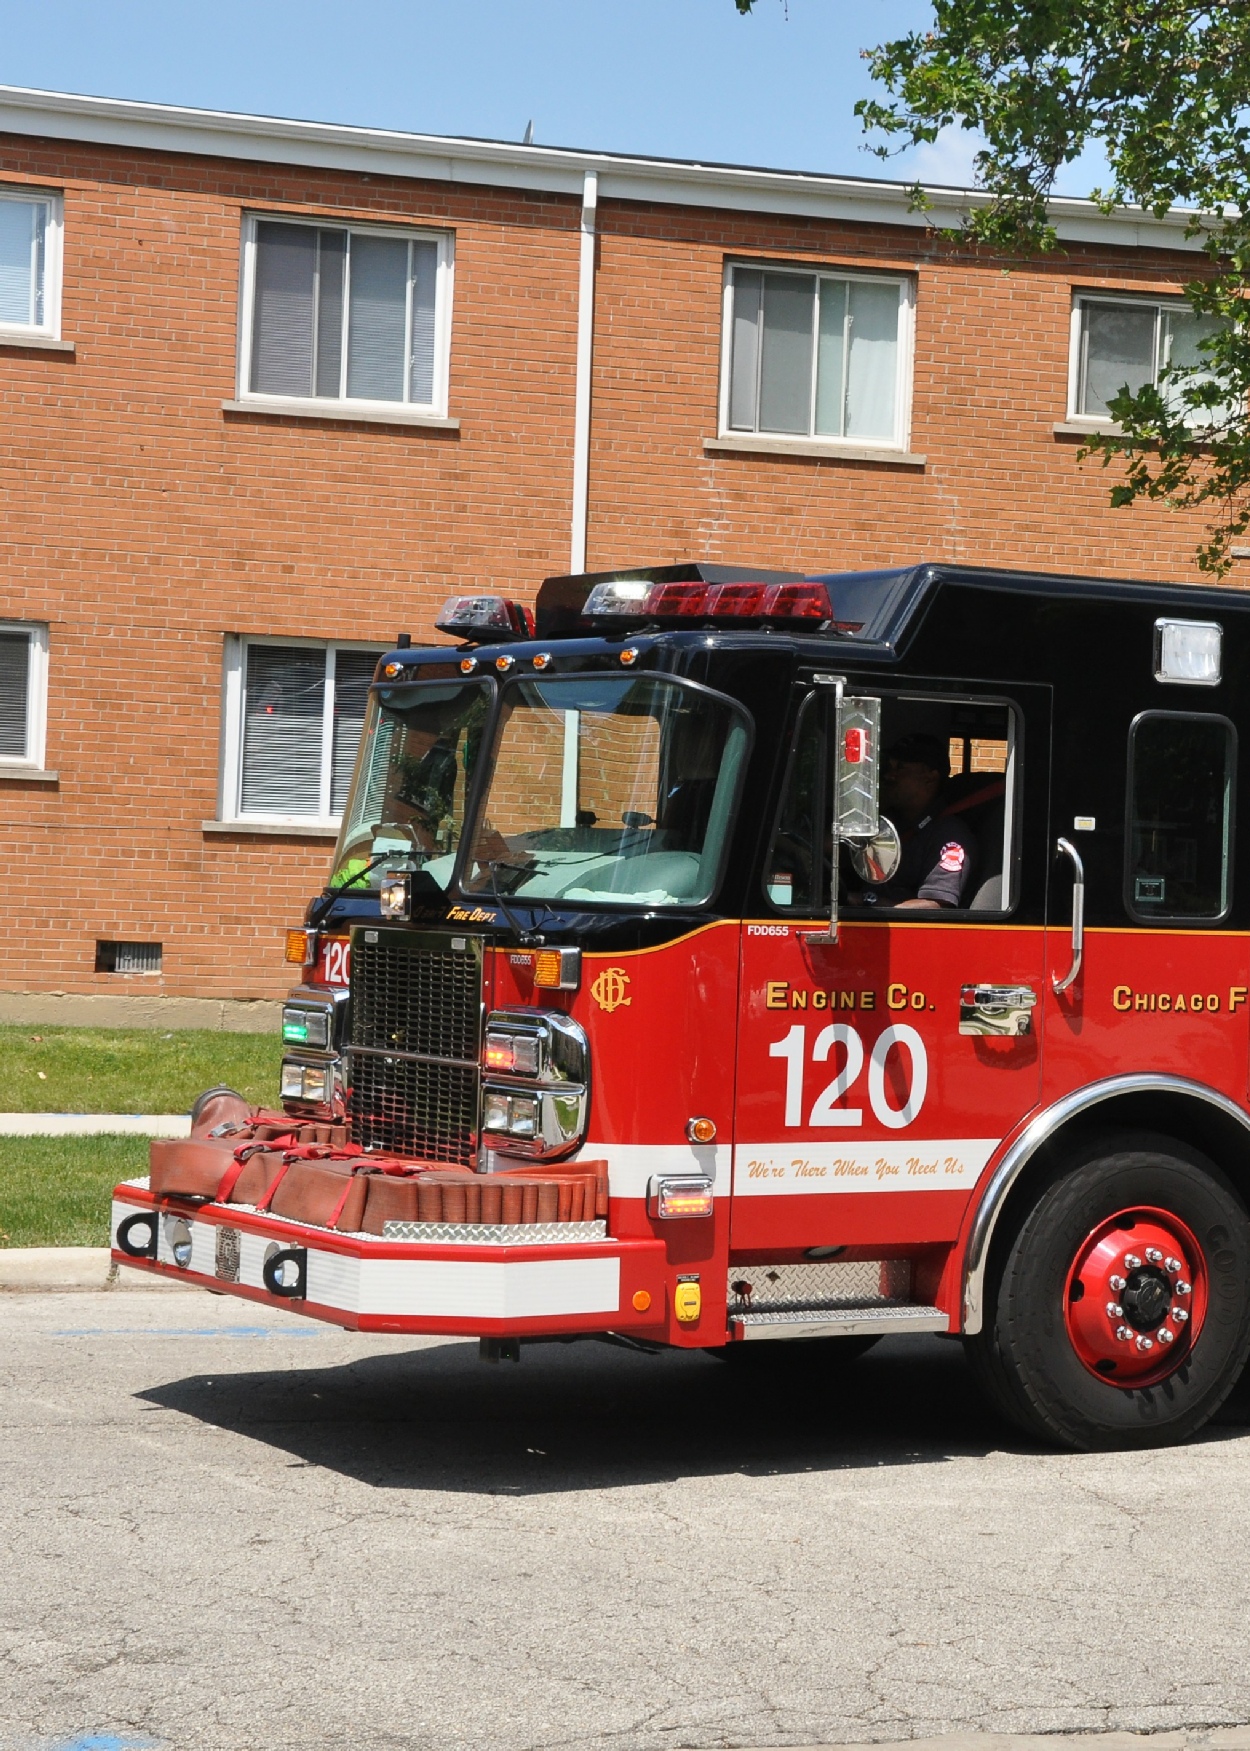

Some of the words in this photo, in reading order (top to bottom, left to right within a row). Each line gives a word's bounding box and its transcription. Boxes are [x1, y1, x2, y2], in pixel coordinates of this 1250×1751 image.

[747, 925, 789, 936] FDD655
[765, 981, 876, 1010] ENGINE
[1112, 985, 1220, 1012] CHICAGO
[768, 1023, 928, 1129] 120
[748, 1160, 785, 1179] We're
[791, 1159, 827, 1178] There
[833, 1159, 869, 1177] When
[875, 1159, 900, 1180] You
[905, 1157, 939, 1177] Need
[943, 1157, 965, 1175] Us
